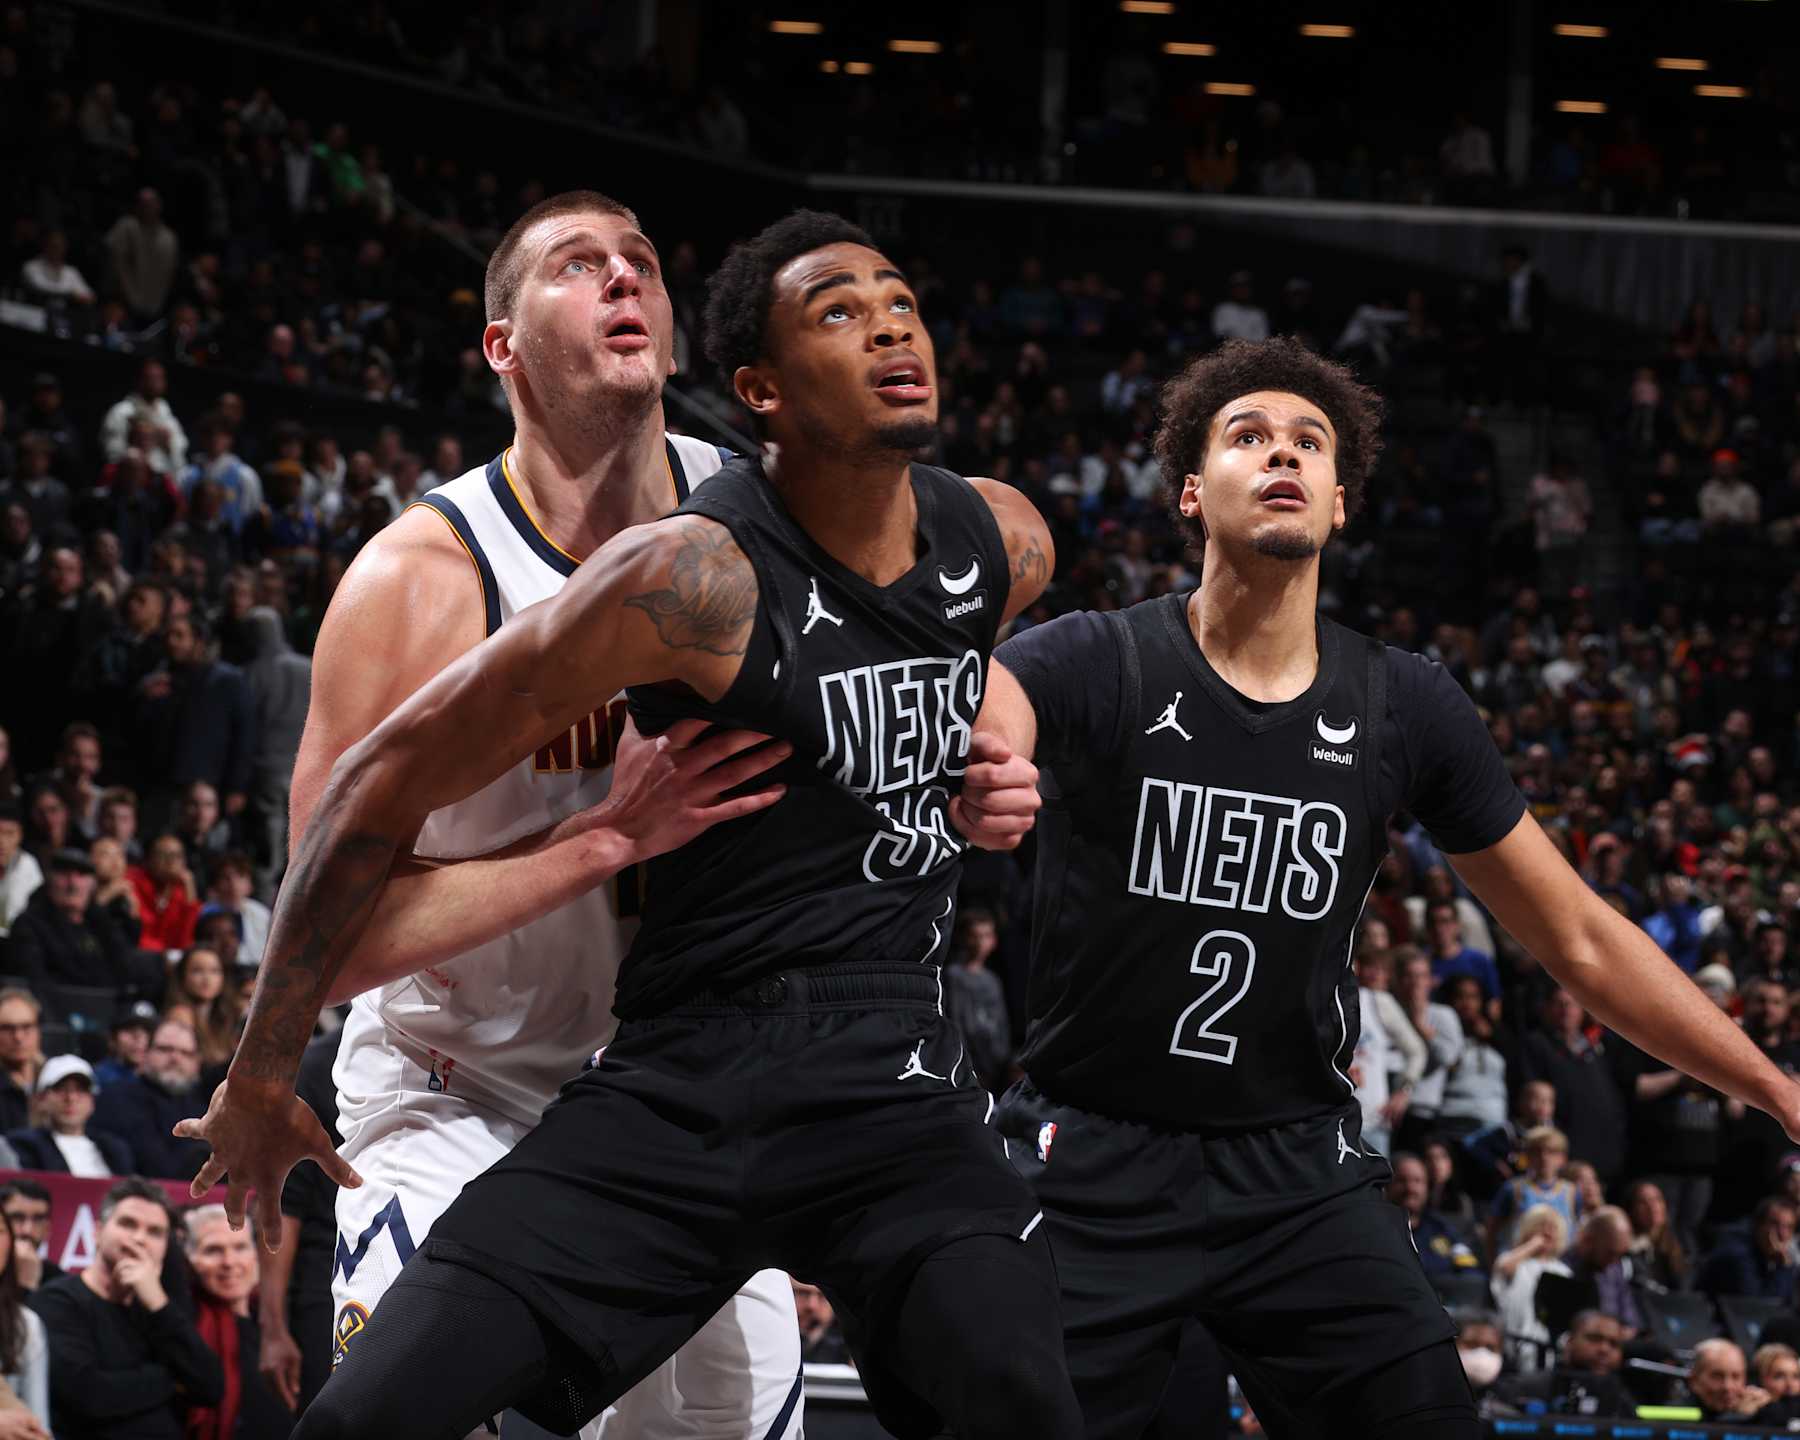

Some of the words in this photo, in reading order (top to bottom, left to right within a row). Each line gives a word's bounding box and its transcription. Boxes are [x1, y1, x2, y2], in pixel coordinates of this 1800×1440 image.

[945, 595, 984, 620] Webull
[816, 648, 983, 796] NETS
[1312, 746, 1353, 766] Webull
[1128, 777, 1347, 921] NETS
[1168, 929, 1256, 1065] 2
